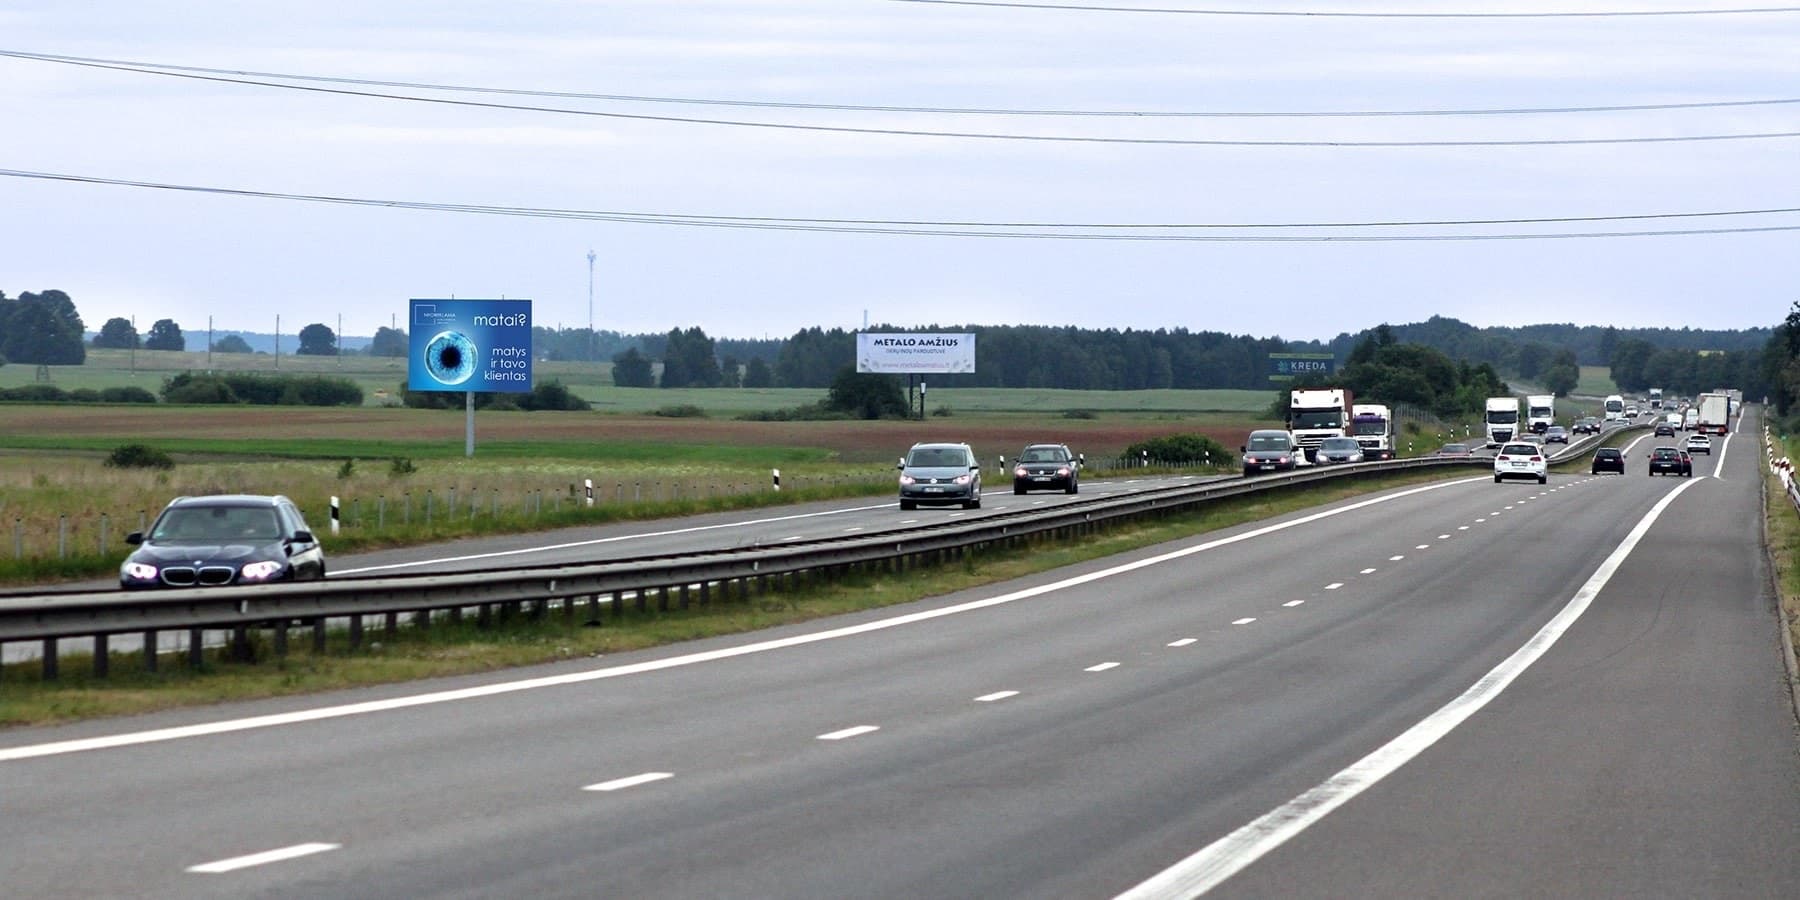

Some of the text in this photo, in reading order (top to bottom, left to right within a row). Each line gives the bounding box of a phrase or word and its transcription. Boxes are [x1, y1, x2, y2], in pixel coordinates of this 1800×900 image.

[474, 313, 527, 327] matai?
[873, 336, 958, 347] METALO AMŽIUS
[492, 346, 526, 358] matys
[490, 358, 527, 369] ir tavo
[1290, 361, 1327, 370] KREDA
[484, 370, 527, 381] klientas
